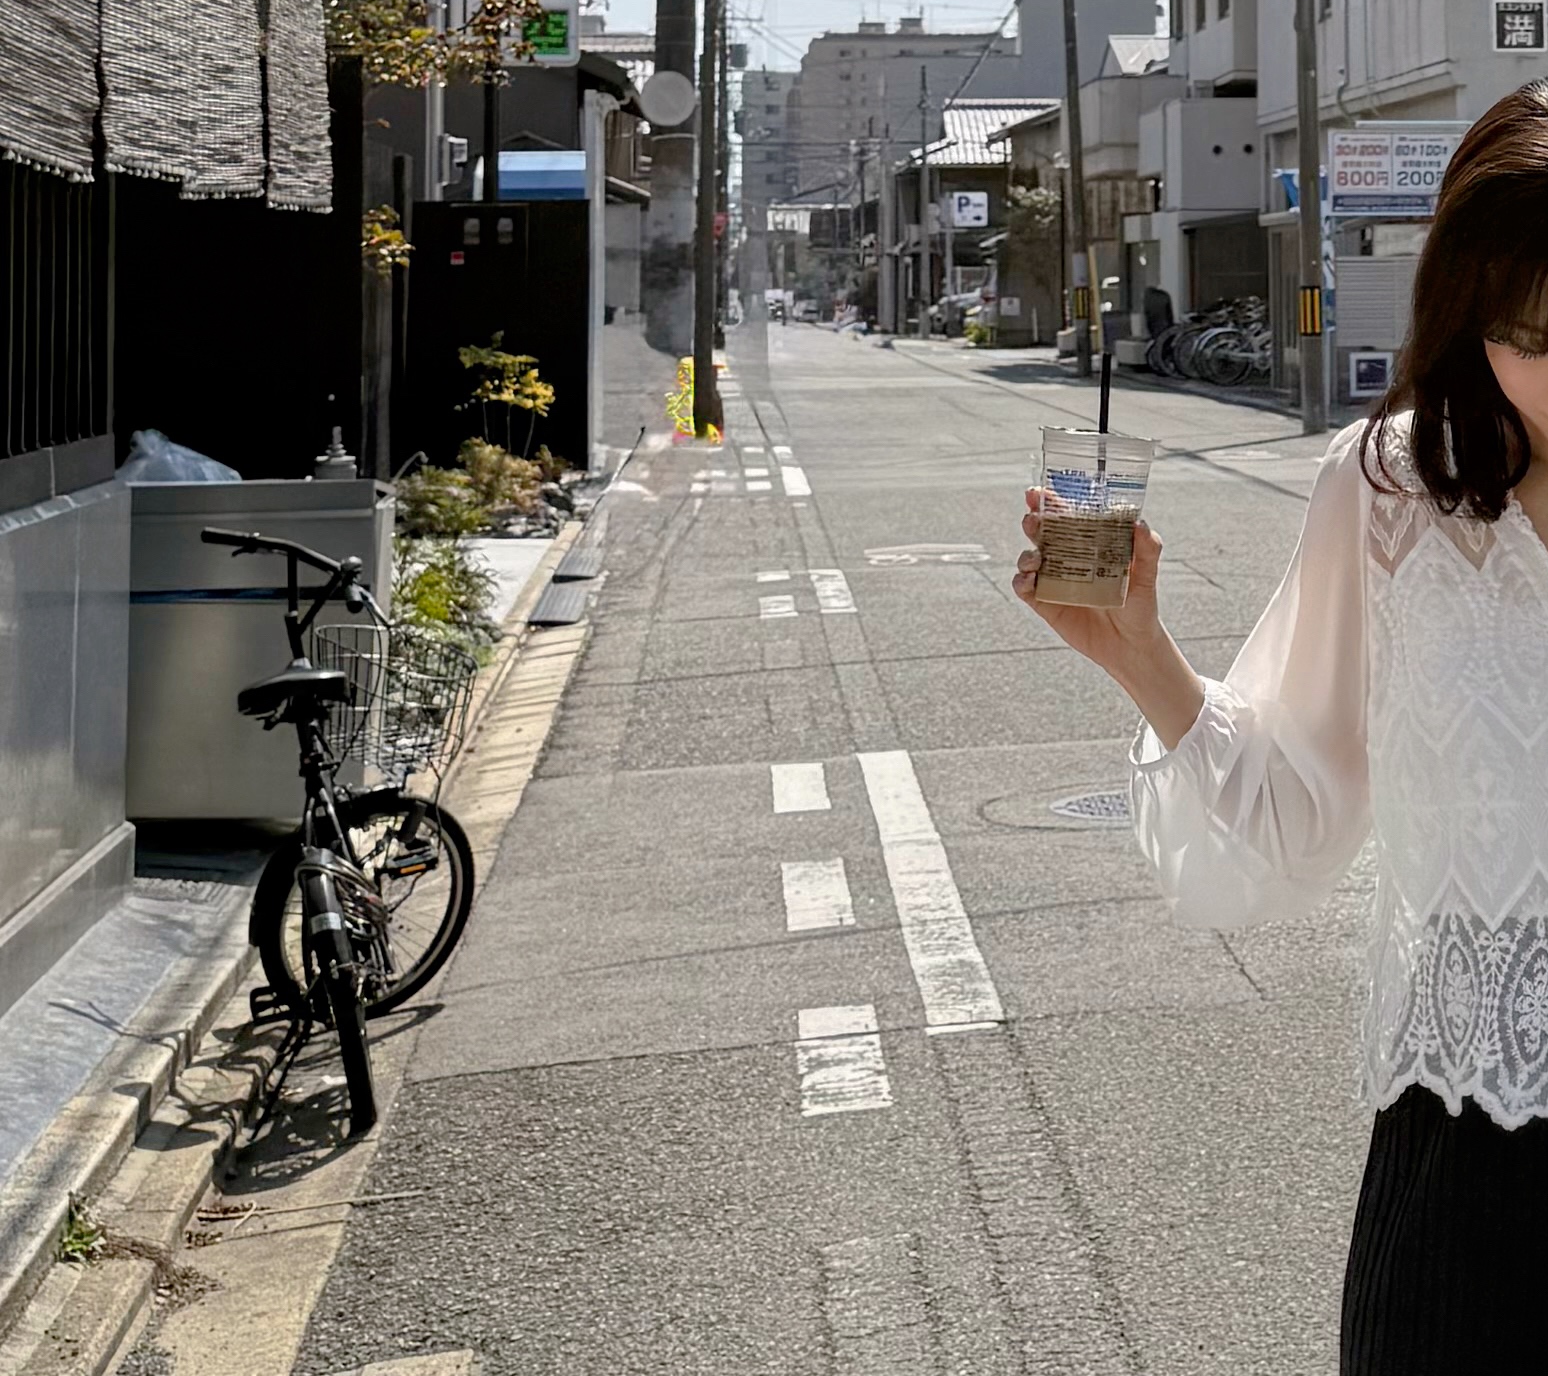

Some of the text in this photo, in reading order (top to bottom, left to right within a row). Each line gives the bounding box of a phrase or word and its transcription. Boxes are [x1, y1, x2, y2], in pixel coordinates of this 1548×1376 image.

[1503, 14, 1536, 46] 満
[1337, 171, 1389, 186] 800円
[958, 196, 971, 213] P
